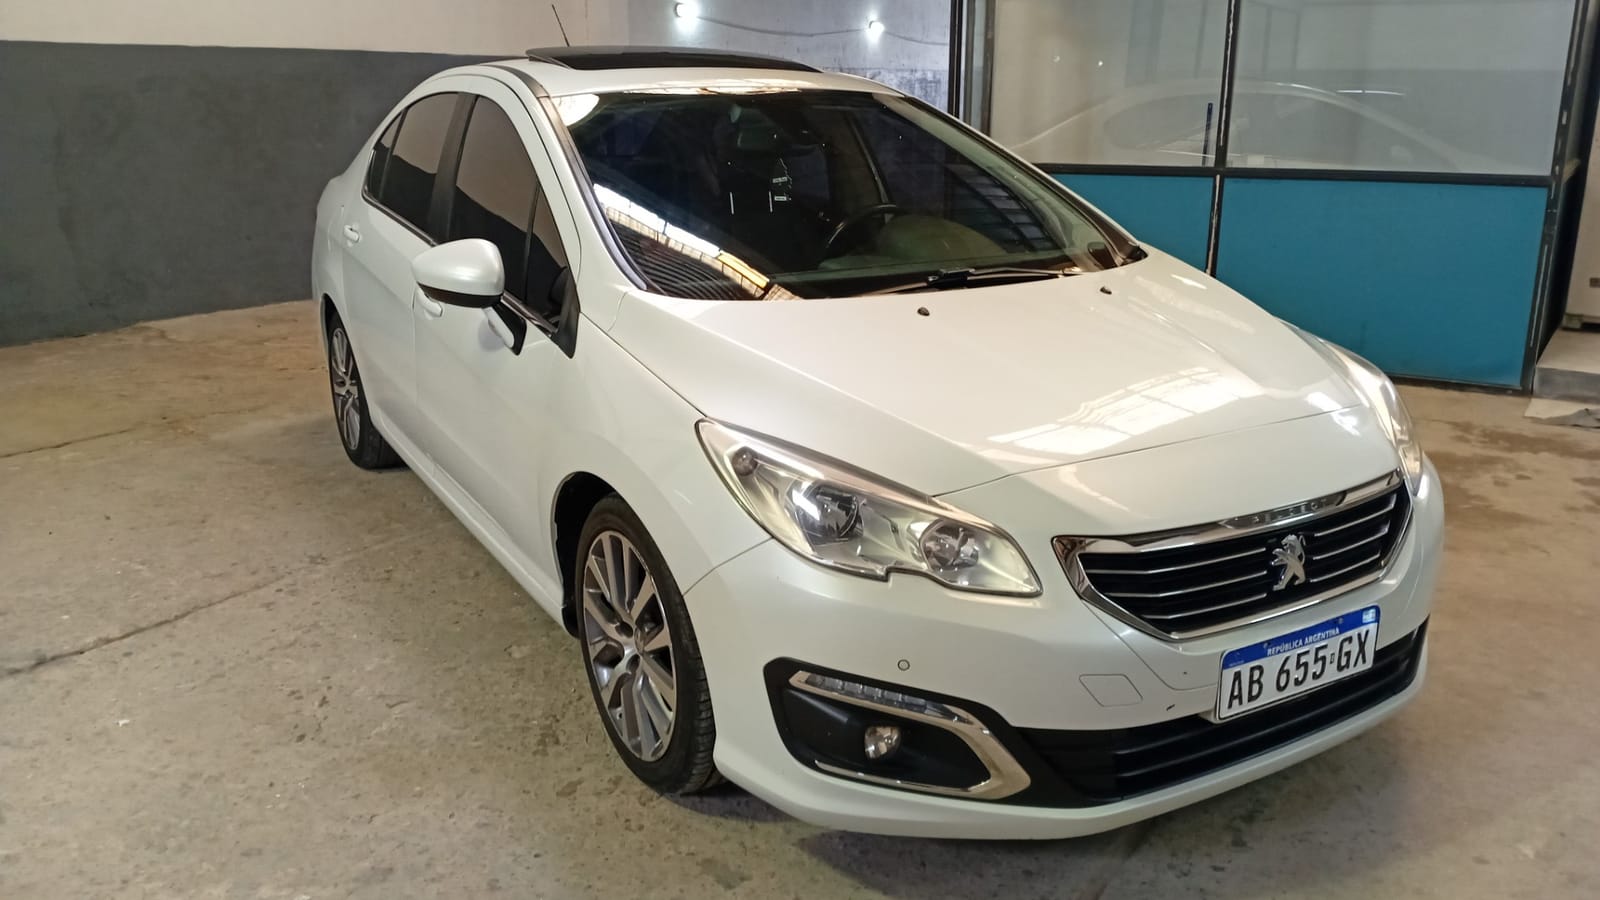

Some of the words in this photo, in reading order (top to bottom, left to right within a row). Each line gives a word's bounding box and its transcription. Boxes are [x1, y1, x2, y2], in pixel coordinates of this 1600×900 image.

[1266, 639, 1303, 656] REPÚBLICA
[1304, 627, 1340, 643] ARGENTINA
[1227, 664, 1264, 709] AB
[1276, 644, 1328, 692] 655
[1336, 629, 1370, 672] GX
